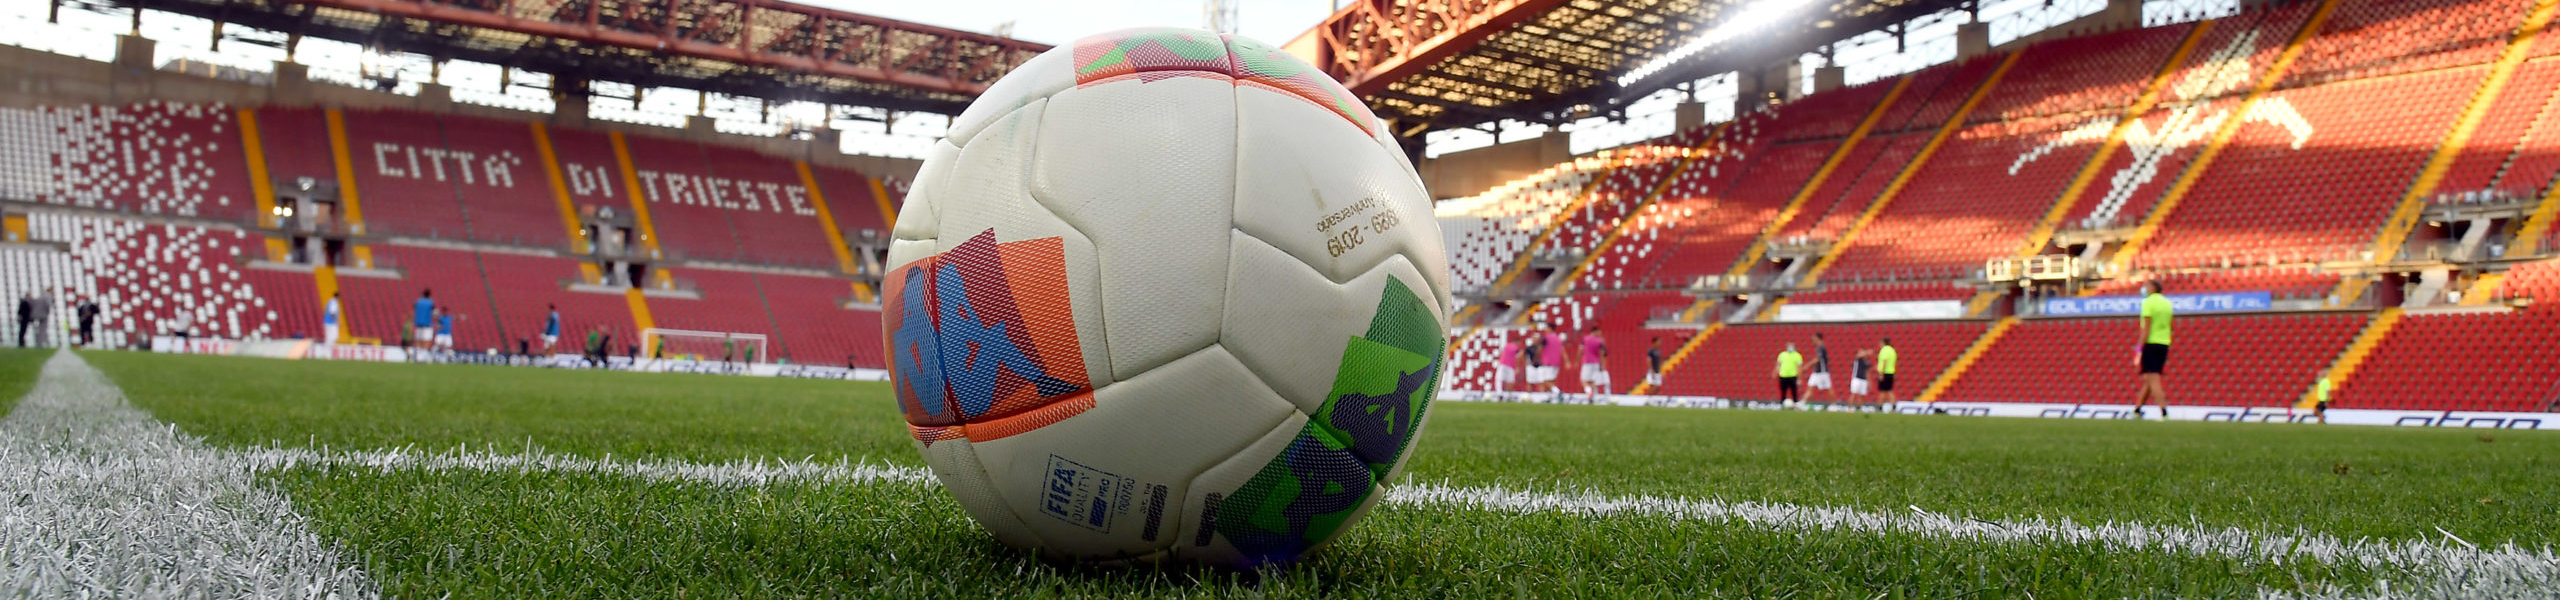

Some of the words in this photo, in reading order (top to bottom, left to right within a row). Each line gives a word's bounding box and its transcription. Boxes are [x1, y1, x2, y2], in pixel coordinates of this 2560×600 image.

[567, 162, 614, 198] DI
[637, 169, 817, 217] TRIESTE
[1316, 197, 1375, 233] Anniversario
[1327, 225, 1364, 257] 2019
[2172, 294, 2234, 311] RIESTE
[1047, 467, 1077, 517] FIFA
[1071, 472, 1090, 522] QUALITY
[1098, 478, 1111, 497] PRO
